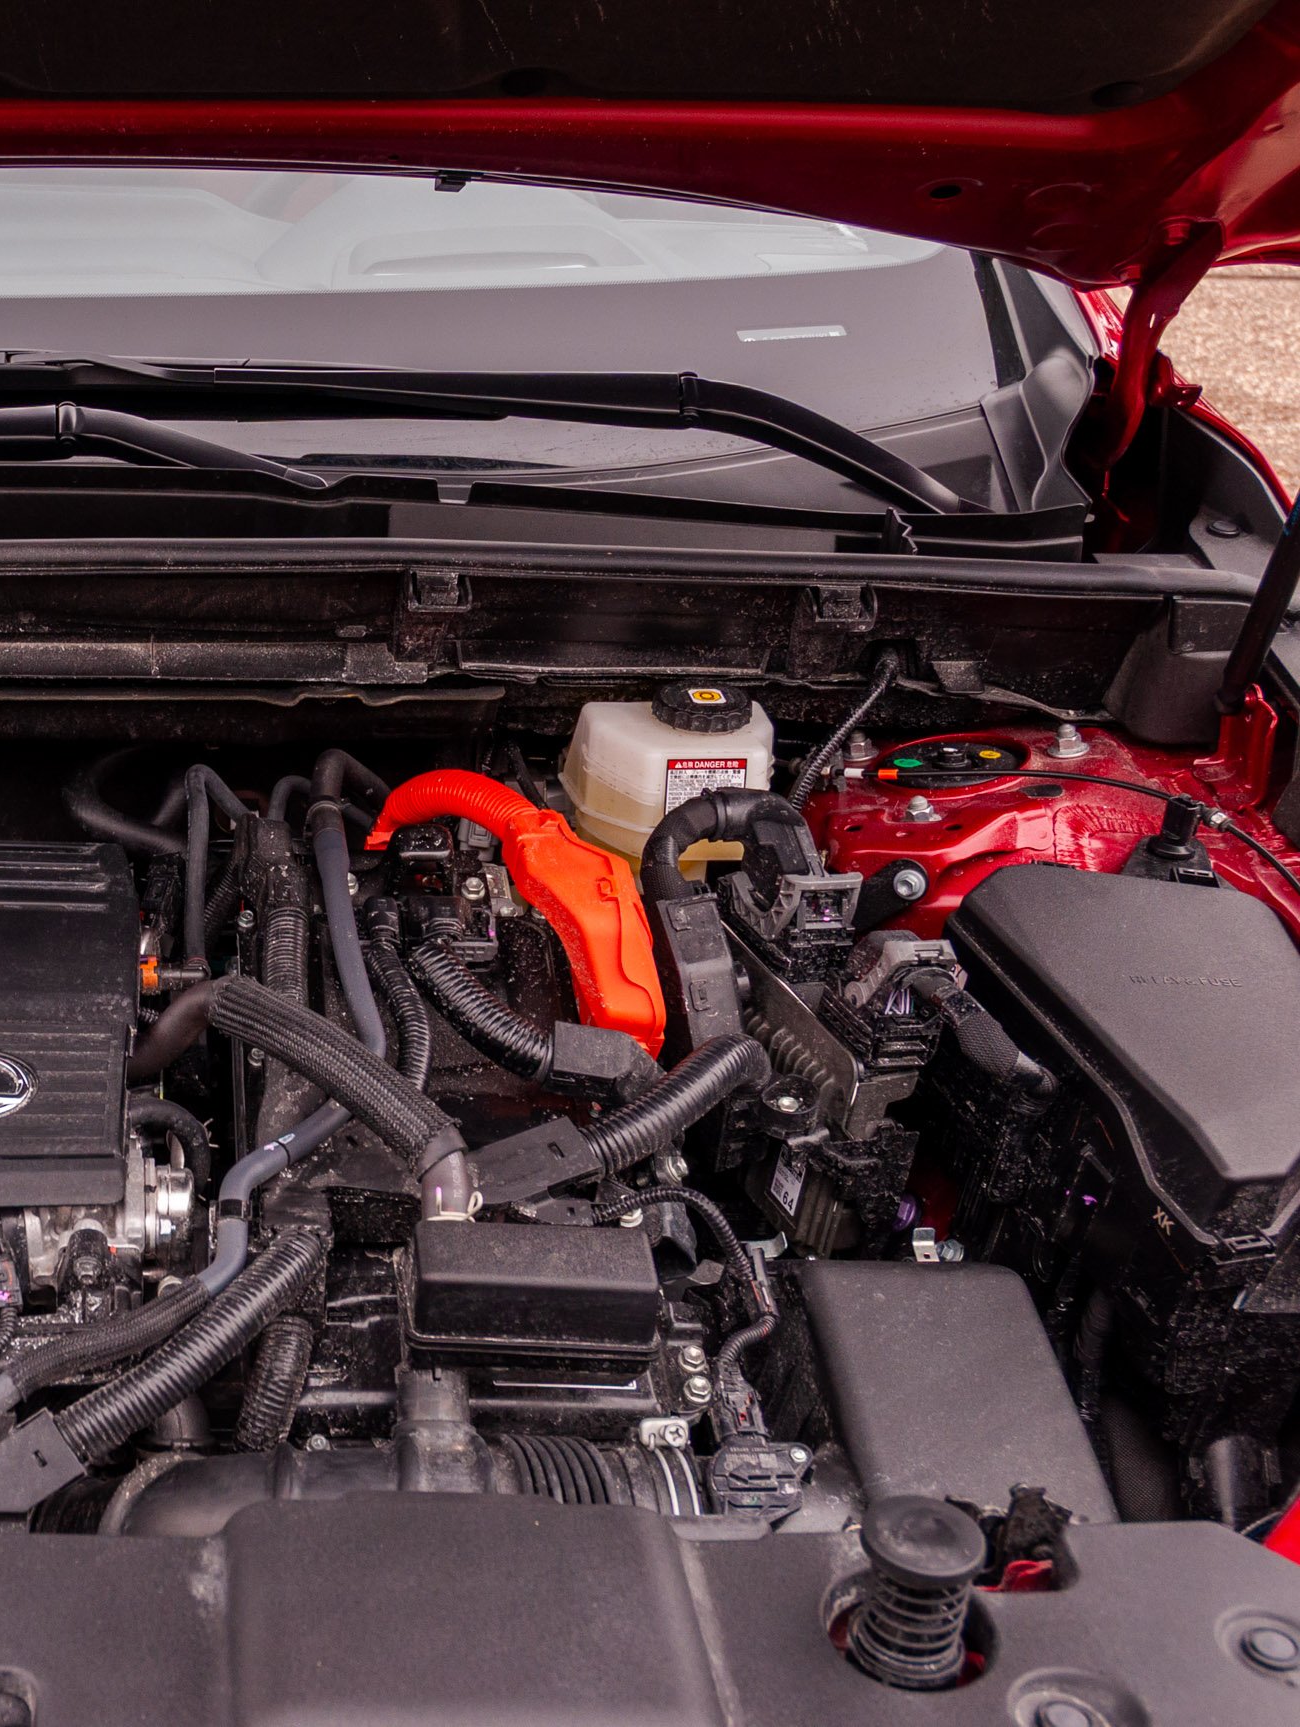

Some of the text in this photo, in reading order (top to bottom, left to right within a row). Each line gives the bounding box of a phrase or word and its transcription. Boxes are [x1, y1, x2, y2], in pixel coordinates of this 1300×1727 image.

[694, 761, 725, 769] DANGER
[1198, 976, 1243, 988] FUSE
[782, 1191, 794, 1212] 64
[1152, 1205, 1175, 1236] XK
